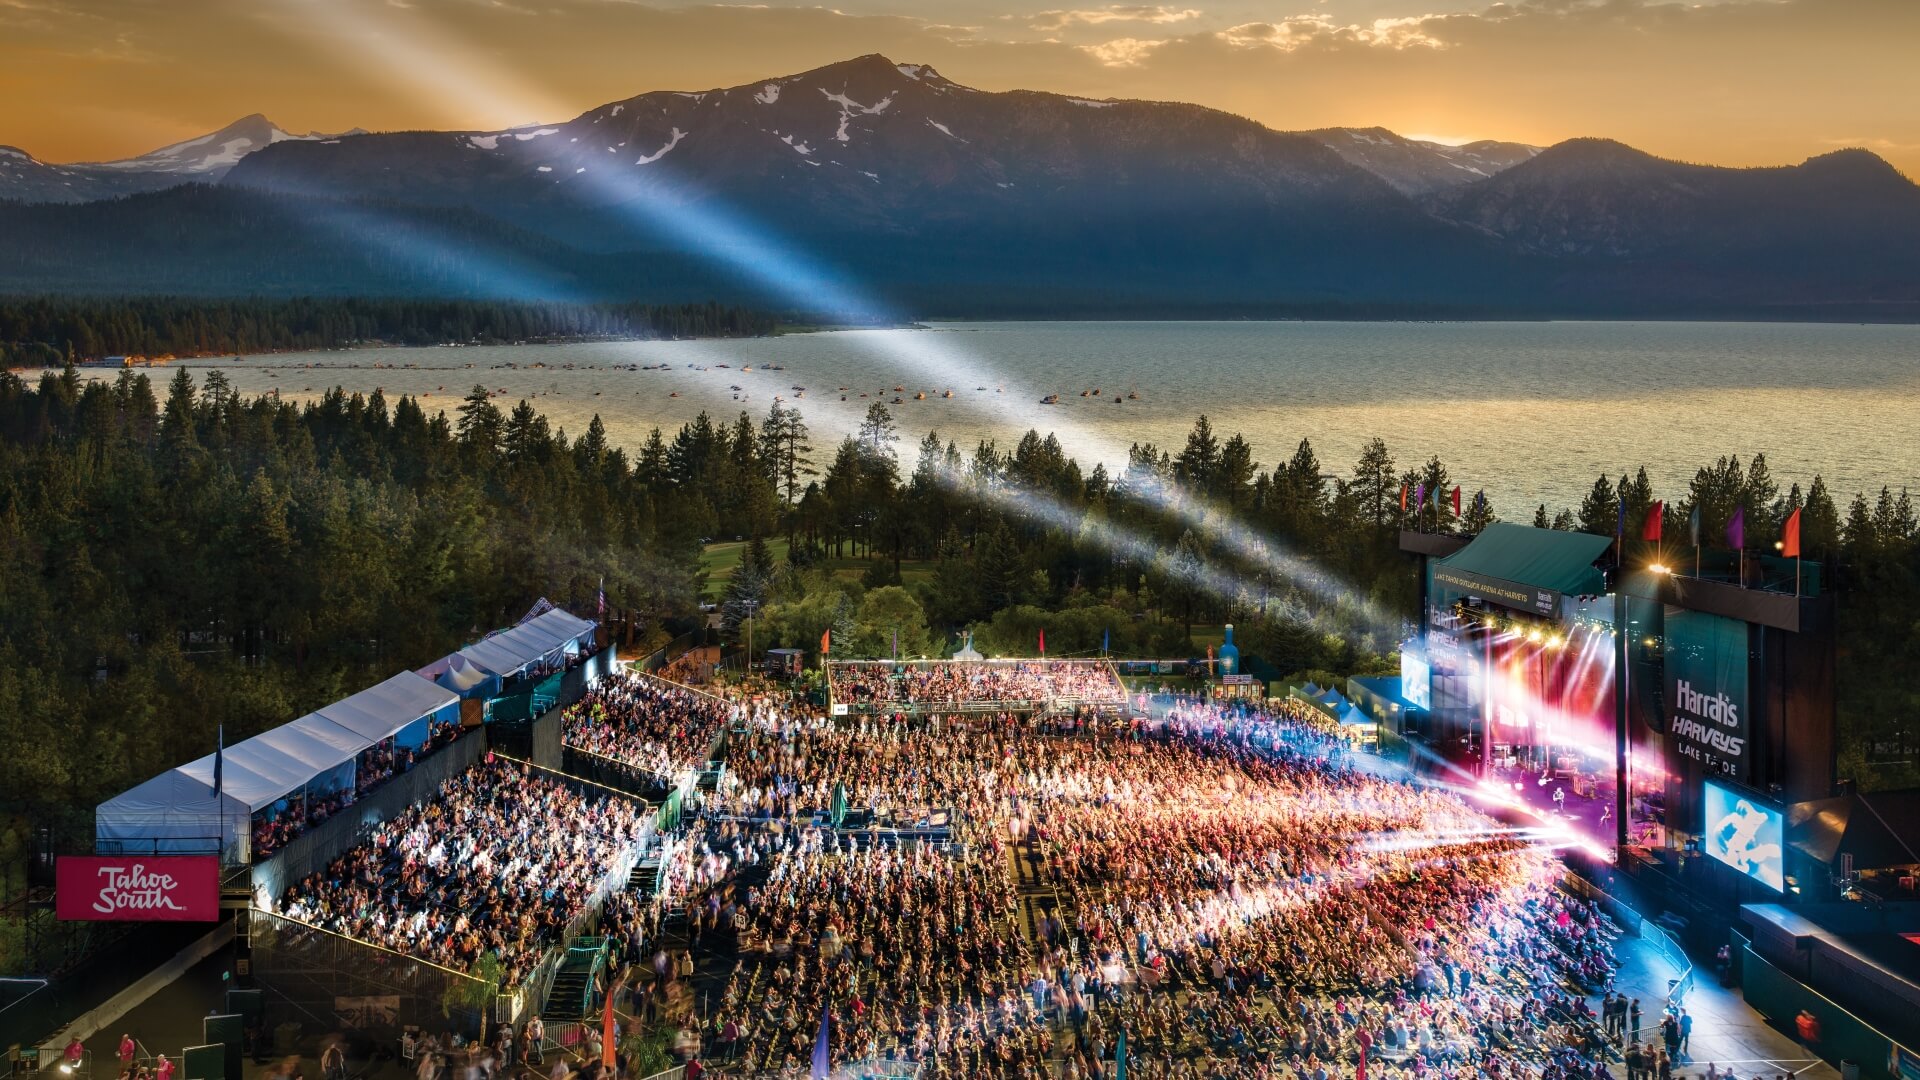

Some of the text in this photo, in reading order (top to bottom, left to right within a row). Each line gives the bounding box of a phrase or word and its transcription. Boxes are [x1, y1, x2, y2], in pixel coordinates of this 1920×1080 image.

[1480, 584, 1497, 594] ARENA
[1497, 588, 1504, 596] AT
[1504, 590, 1528, 602] HARVEYS
[1672, 715, 1745, 756] HARVEYS
[1678, 742, 1736, 775] LAKE TOE
[97, 863, 178, 890] Tahoe
[92, 887, 183, 913] South
